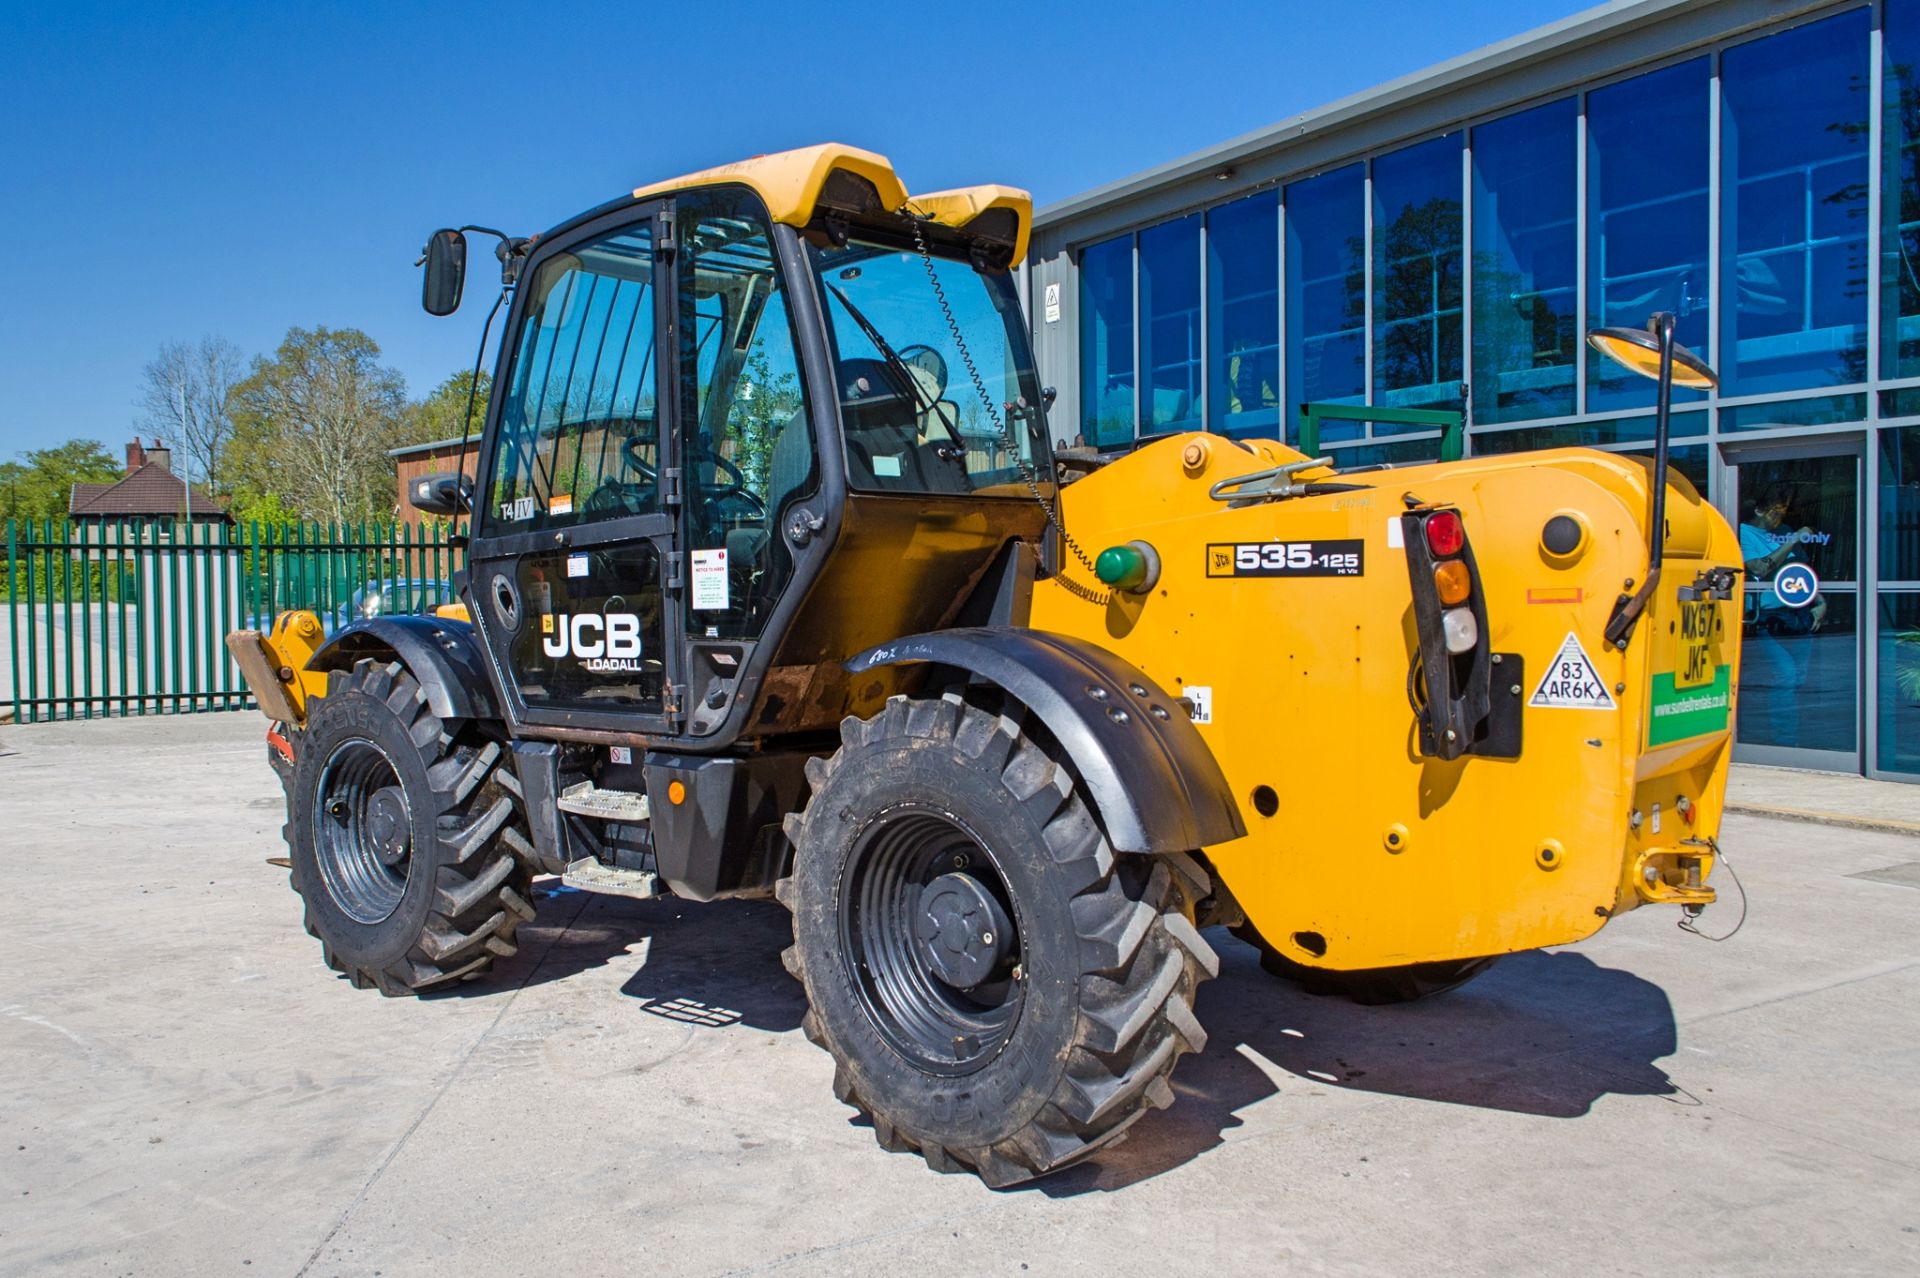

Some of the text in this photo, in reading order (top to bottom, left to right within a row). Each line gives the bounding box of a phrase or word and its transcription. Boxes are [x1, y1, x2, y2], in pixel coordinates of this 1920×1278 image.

[1766, 531, 1830, 546] Staff Only
[1214, 553, 1231, 568] JCB
[542, 613, 641, 658] JCB
[587, 658, 641, 671] LOADALL
[1561, 662, 1583, 679] 83
[1684, 644, 1708, 681] JKF
[1549, 681, 1595, 699] AR6K
